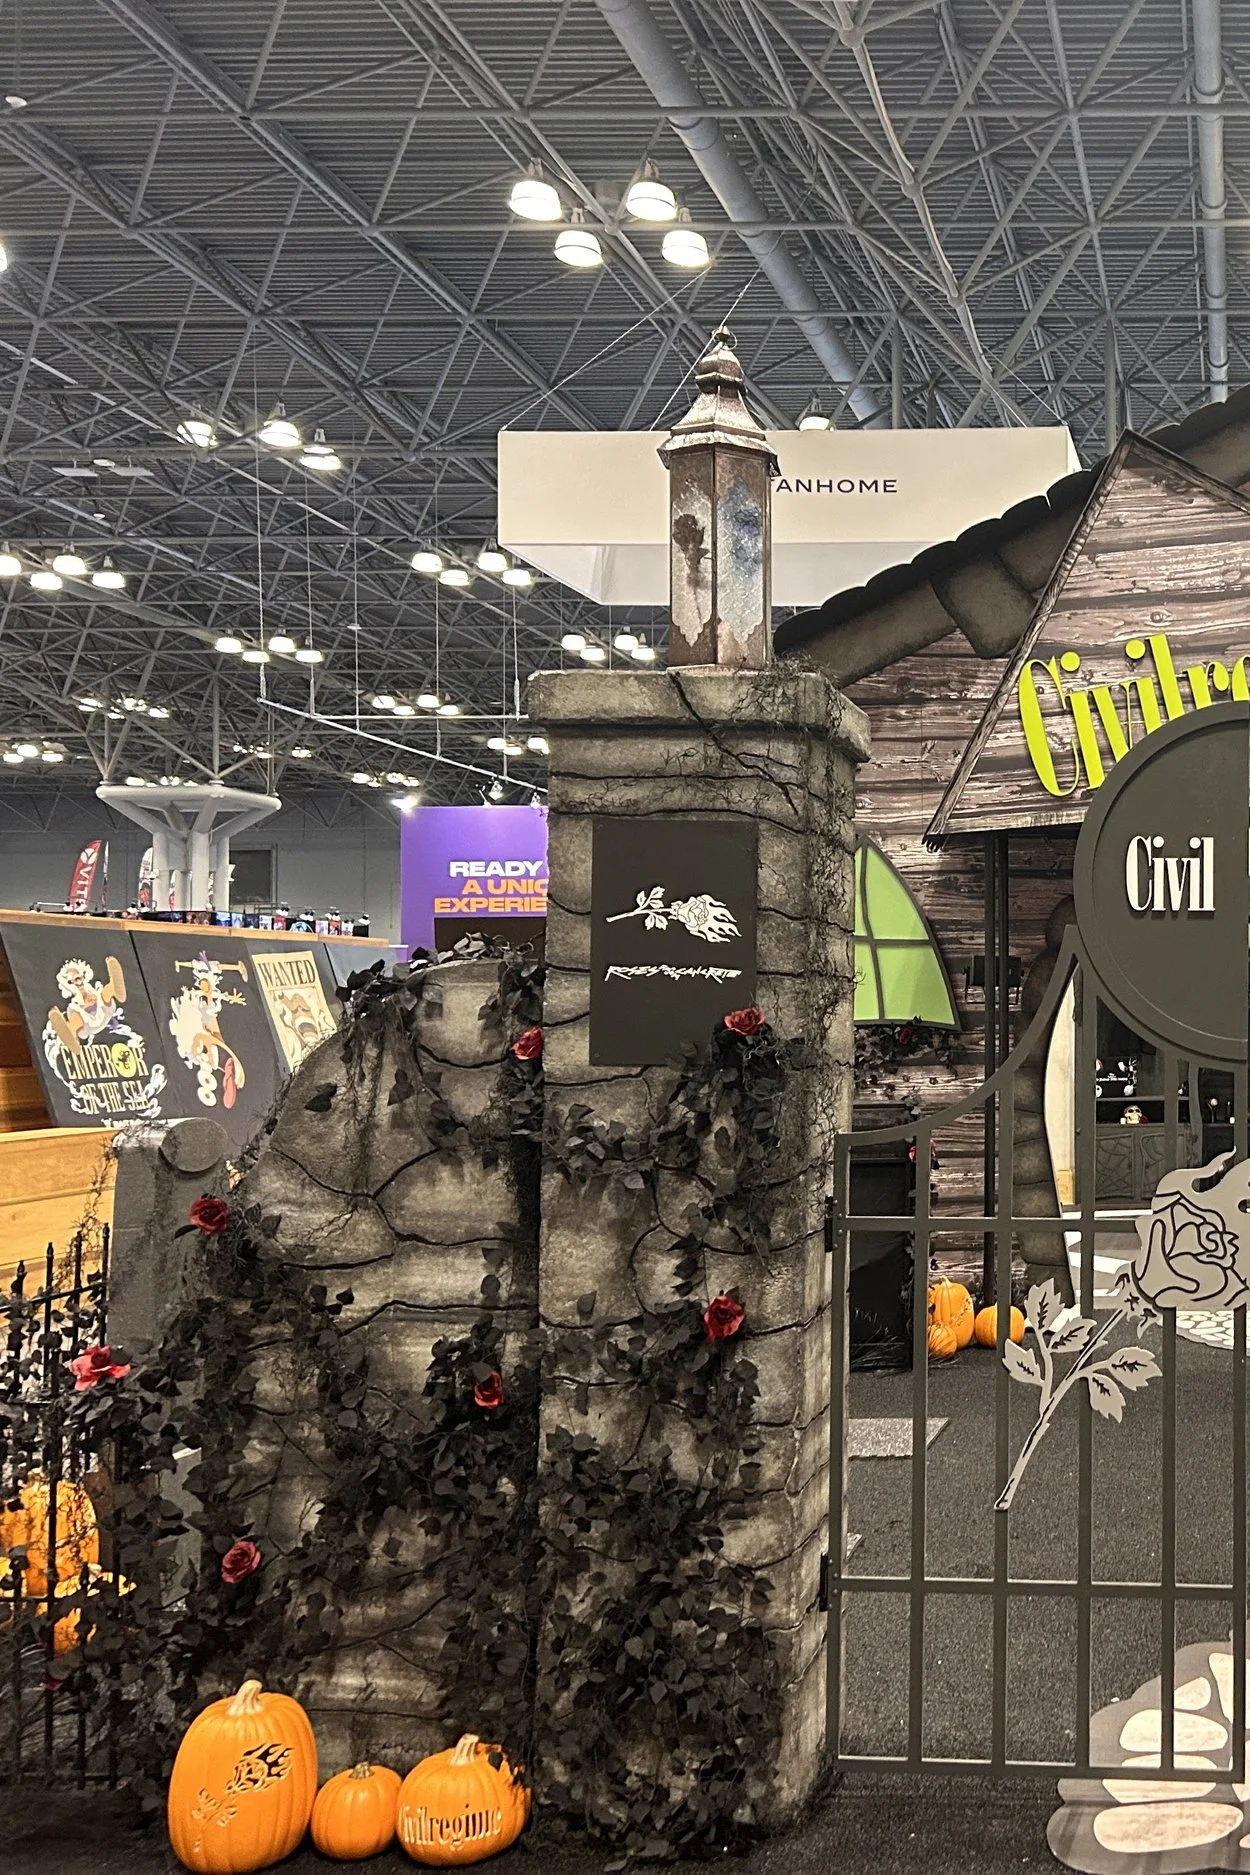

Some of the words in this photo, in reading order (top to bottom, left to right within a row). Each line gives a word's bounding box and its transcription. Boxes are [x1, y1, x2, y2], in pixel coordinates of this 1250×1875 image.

[771, 478, 898, 494] ANHOME
[450, 860, 544, 878] READY
[1125, 834, 1216, 912] Civil
[462, 878, 483, 895] A
[434, 896, 549, 914] EXPERIE
[257, 959, 316, 987] WANTED
[59, 1043, 150, 1080] EMPEROR
[97, 1081, 127, 1112] THE
[121, 1080, 151, 1111] SEA
